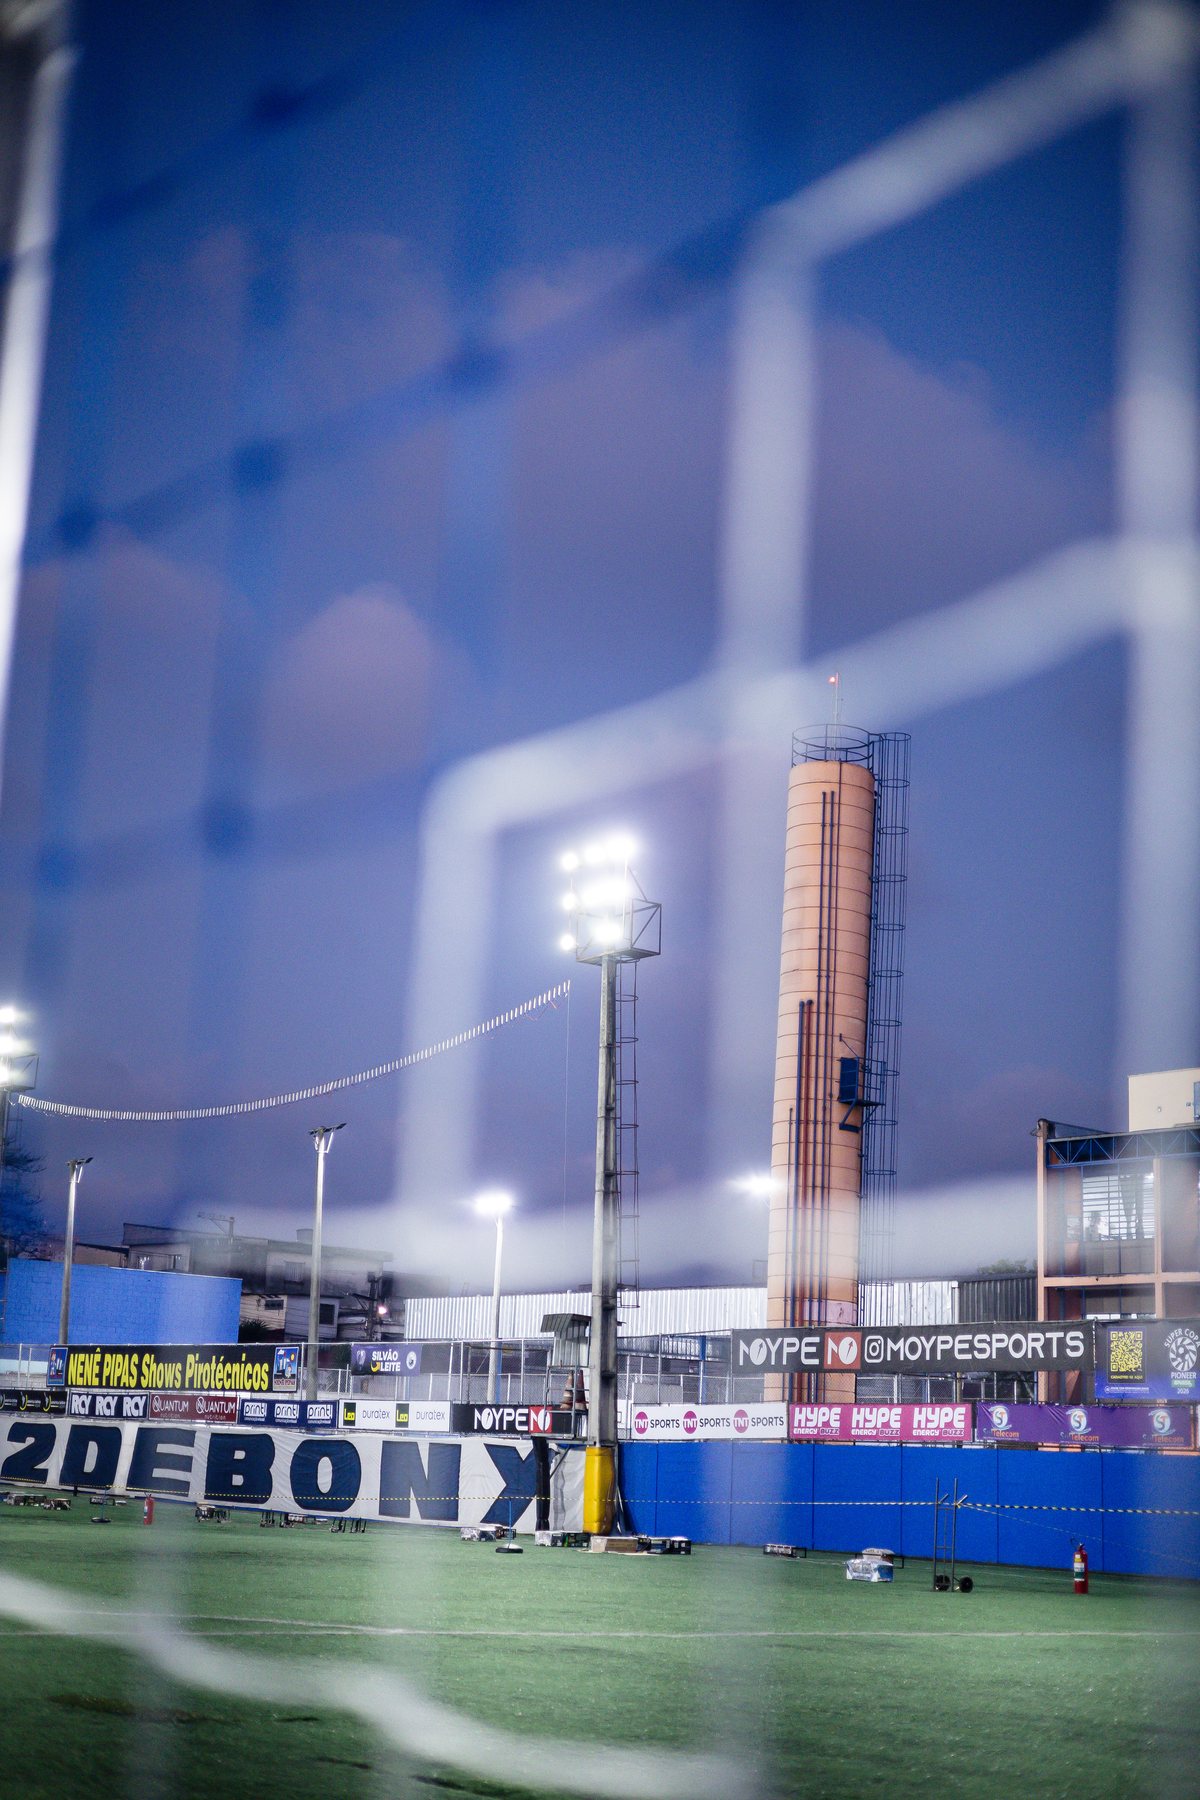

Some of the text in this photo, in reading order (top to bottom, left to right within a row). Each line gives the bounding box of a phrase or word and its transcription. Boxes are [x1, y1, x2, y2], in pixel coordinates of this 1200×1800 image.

[886, 1331, 1084, 1361] MOYPESPORTS
[1164, 1328, 1183, 1348] SUPER
[372, 1349, 398, 1361] SILVÃO
[68, 1348, 269, 1391] NENÊ PIPAS Shows Pirotécnicos
[380, 1362, 401, 1372] LEITE
[71, 1394, 92, 1415] RCY
[95, 1396, 118, 1416] RCY
[123, 1396, 146, 1417] RCY
[152, 1395, 236, 1414] QUANTUM QUANTUM
[650, 1419, 680, 1429] SPORTS
[699, 1417, 730, 1428] SPORTS
[751, 1415, 784, 1427] SPORTS
[794, 1407, 966, 1429] HYPE HYPE HYPE
